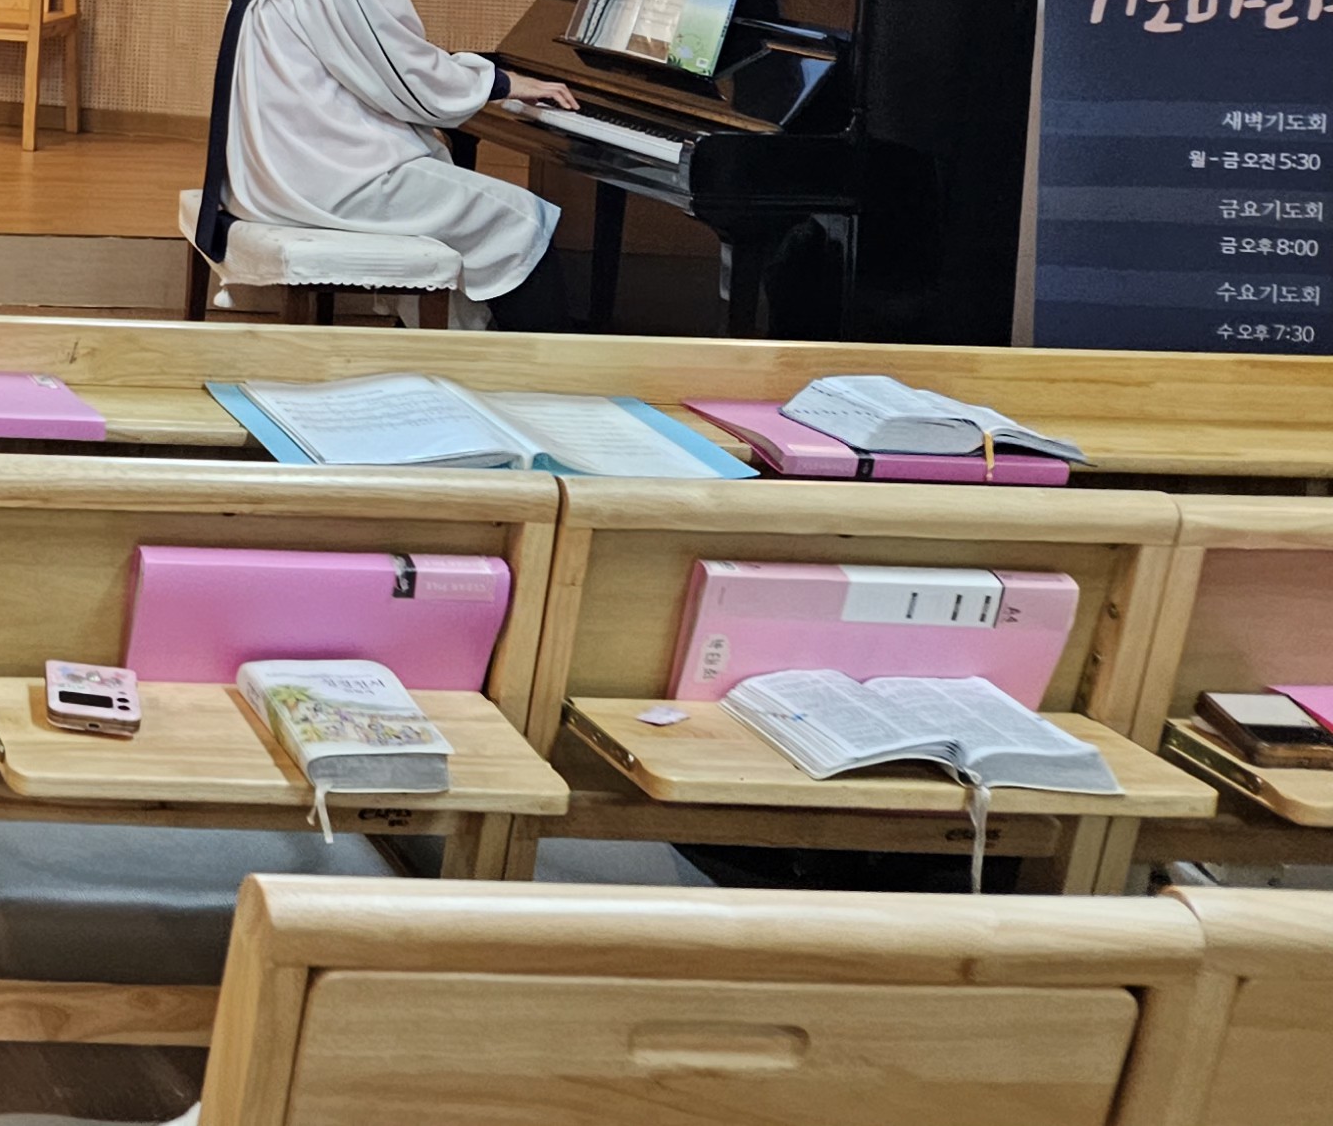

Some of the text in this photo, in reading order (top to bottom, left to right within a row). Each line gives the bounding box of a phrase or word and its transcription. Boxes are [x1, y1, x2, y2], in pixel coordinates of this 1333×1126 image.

[1222, 110, 1327, 134] 새벽기도회
[1278, 152, 1321, 171] 5:30
[1218, 199, 1323, 222] 금요기도회
[1276, 238, 1319, 257] 8:00
[1216, 281, 1321, 306] 수요기도회
[1274, 324, 1315, 343] 7:30
